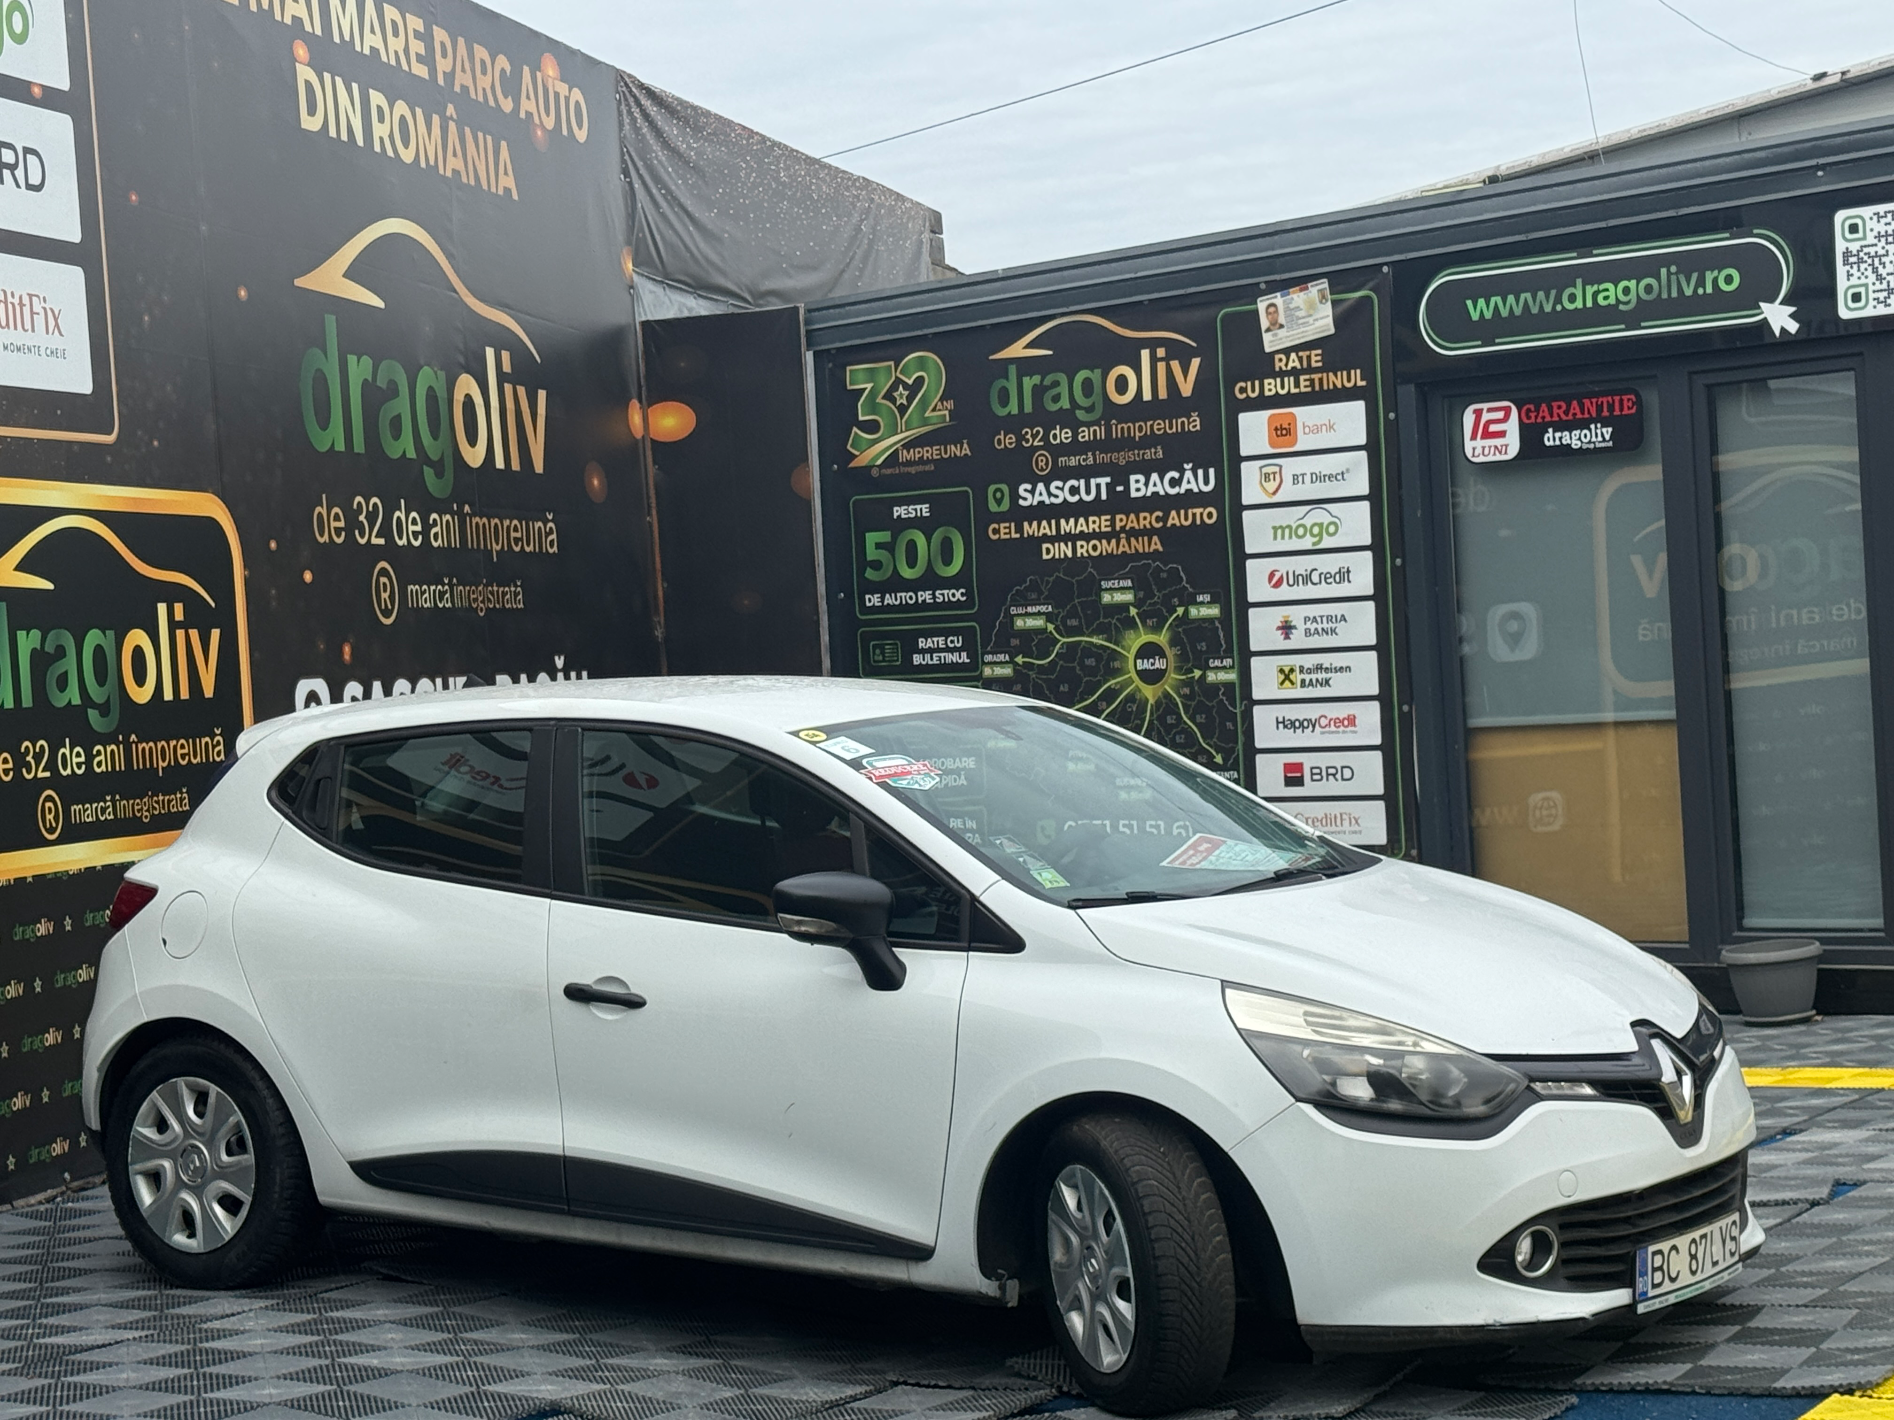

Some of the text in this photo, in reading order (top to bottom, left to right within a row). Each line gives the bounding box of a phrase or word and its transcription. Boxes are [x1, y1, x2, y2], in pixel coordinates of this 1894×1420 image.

[331, 0, 429, 80] MARE
[432, 24, 513, 113] PARC
[519, 64, 589, 144] AUTO
[295, 62, 518, 200] DIN ROMÂNIA
[1466, 265, 1741, 323] www.dragoliv.ro
[2, 342, 67, 360] MOMENTE CHEIE
[1274, 349, 1323, 371] RATE
[989, 347, 1201, 422] dragoliv
[1234, 369, 1367, 400] CU BULETINUL
[301, 313, 547, 499] dragoliv
[846, 351, 946, 456] 32
[936, 400, 954, 411] ANI
[1520, 394, 1637, 423] GARANTIE
[994, 412, 1200, 449] de 32 de ani împreună
[1273, 419, 1336, 437] tbi bank
[1470, 406, 1512, 441] 12
[1544, 423, 1613, 449] dragoliv
[898, 439, 972, 463] ÎMPREUNĂ
[1058, 452, 1093, 468] marcă
[1096, 446, 1163, 465] înregistrată
[1471, 444, 1509, 458] LUNI
[1018, 477, 1111, 507] SASCUT
[1129, 463, 1215, 498] BACĂU
[1263, 471, 1278, 483] BT
[1292, 472, 1306, 486] BT
[893, 504, 930, 519] PESTE
[988, 507, 1217, 540] CEL MAI MARE PARC AUTO
[313, 494, 558, 562] de 32 de ani împreună
[1272, 521, 1339, 547] mogo
[864, 526, 965, 581] 500
[1041, 534, 1163, 560] DIN ROMÂNIA
[1101, 579, 1132, 589] SUCEAVA
[1286, 566, 1351, 587] UniCredit
[407, 577, 451, 609] marcă
[452, 578, 524, 617] înregistrată
[865, 588, 967, 606] DE AUTO PE STOC
[1010, 605, 1052, 614] CLUJ-NAPOCA
[1303, 614, 1347, 625] PATRIA
[918, 636, 963, 649] RATE CU
[1304, 627, 1338, 638] BANK
[912, 652, 970, 665] BULETINUL
[984, 654, 1009, 662] ORADEA
[1136, 656, 1166, 670] BACĂU
[1299, 664, 1351, 675] Raiffeisen
[1300, 677, 1332, 688] BANK
[1276, 714, 1357, 734] HappyCredit
[20, 739, 51, 780] 32
[57, 737, 86, 776] de
[92, 735, 125, 775] ani
[129, 727, 225, 777] împreună
[1310, 766, 1354, 782] BRD
[71, 795, 114, 825] marcă
[117, 786, 190, 823] înregistrată
[12, 918, 54, 942] dragoliv
[54, 963, 95, 988] dragoliv
[21, 1027, 63, 1052] dragoliv
[28, 1136, 70, 1164] dragoliv
[1651, 1243, 1681, 1290] BC
